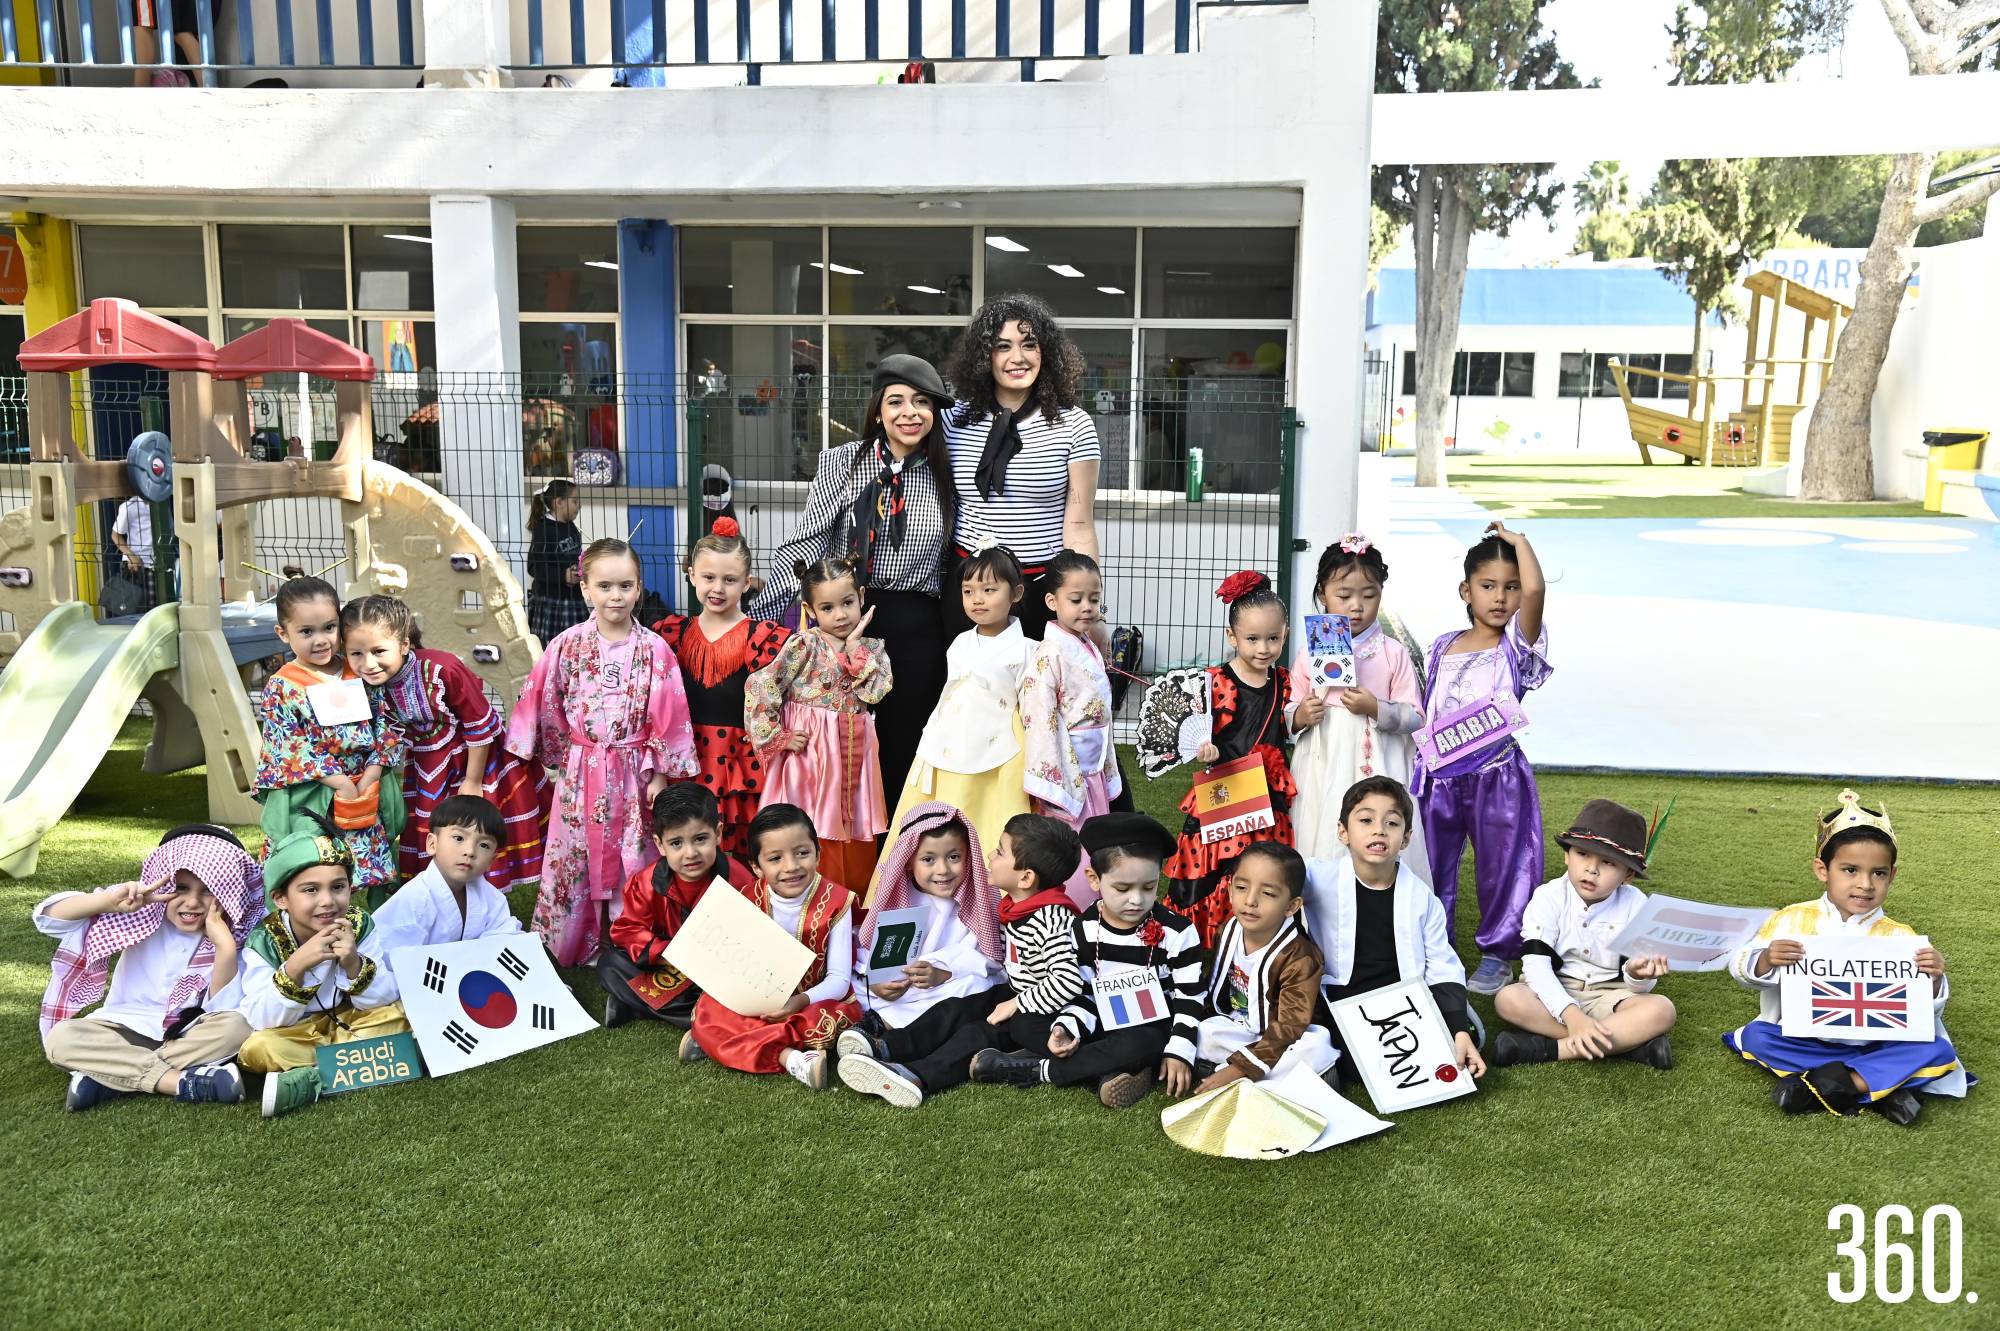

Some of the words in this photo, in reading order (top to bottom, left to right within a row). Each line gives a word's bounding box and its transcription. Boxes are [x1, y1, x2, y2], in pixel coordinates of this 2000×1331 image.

[1434, 706, 1505, 754] ARABIA
[1206, 815, 1268, 842] ESPAÑA
[1095, 972, 1157, 994] FRANCIA
[335, 1040, 395, 1066] Saudi
[1358, 995, 1430, 1089] JAPAN
[332, 1058, 410, 1089] Arabia
